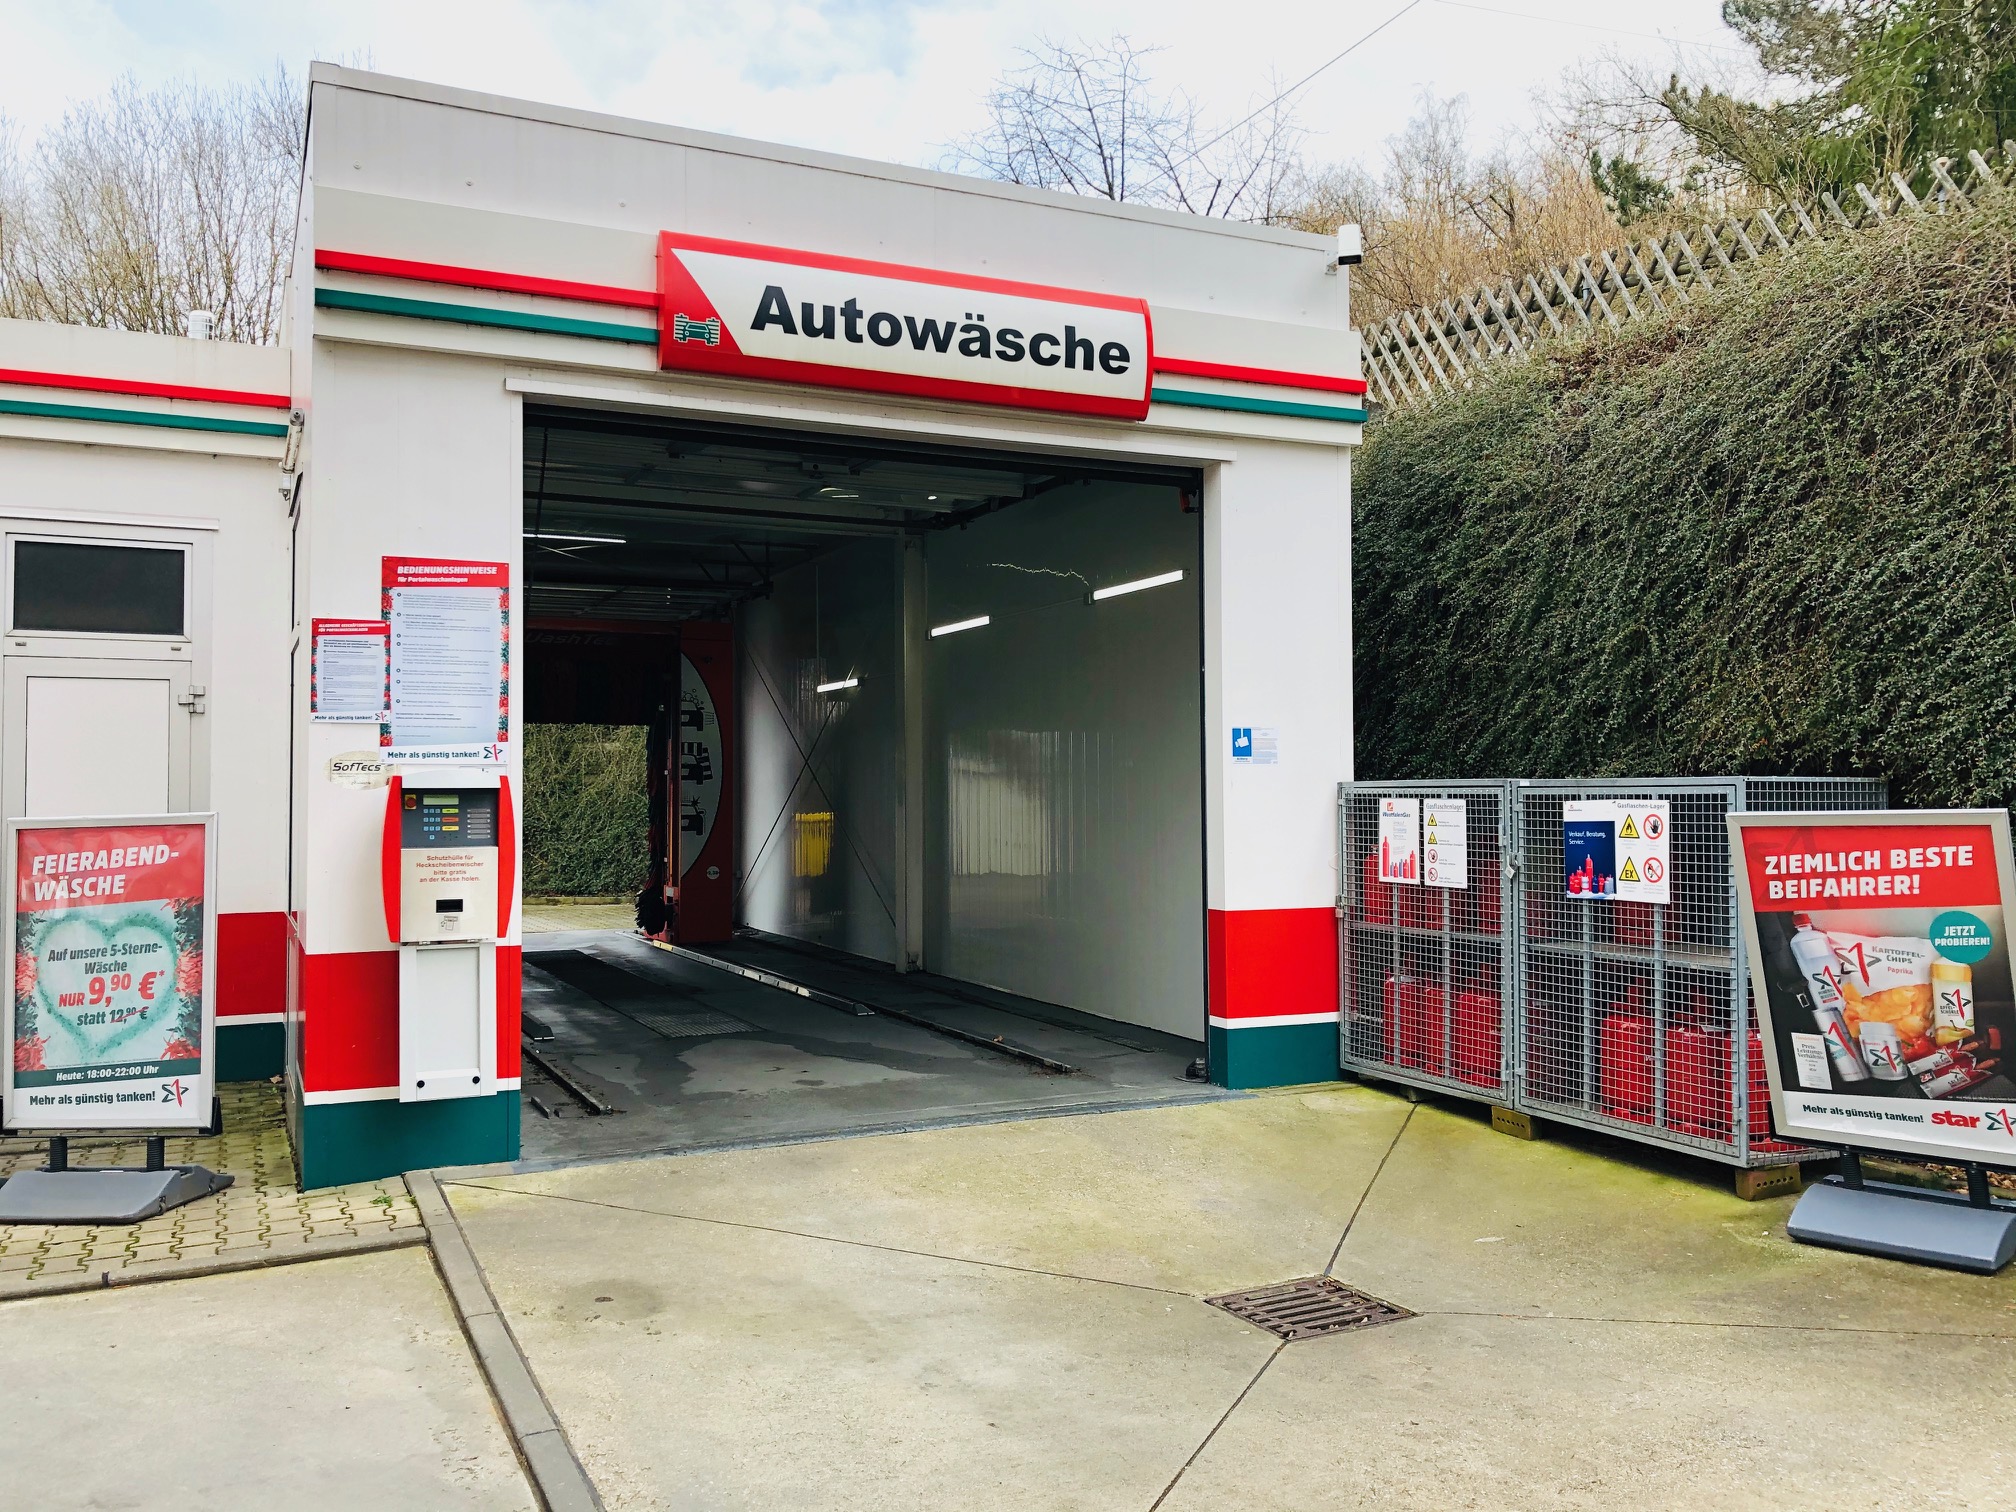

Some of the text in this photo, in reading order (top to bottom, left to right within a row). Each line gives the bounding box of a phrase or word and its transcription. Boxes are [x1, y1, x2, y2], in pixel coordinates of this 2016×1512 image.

[750, 284, 1131, 376] Autowäsche
[397, 566, 497, 575] BEDIENUNGSHINWEISE
[408, 576, 468, 584] Portalwaschanlagen
[387, 750, 480, 761] Mehr als günstig tanken!
[332, 762, 381, 772] SofTecs
[1426, 803, 1464, 811] Gasflaschenlager
[1617, 802, 1665, 810] Gasflaschen-Lager
[32, 844, 179, 876] FEIERABEND-
[1765, 845, 1973, 875] ZIEMLICH BESTE
[449, 869, 466, 877] gratis
[1625, 869, 1634, 879] EX
[34, 874, 126, 902] WÄSCHE
[1768, 875, 1921, 899] BEIFAHRER!
[1943, 925, 1976, 937] JETZT
[1934, 936, 1990, 946] PROBIEREN!
[48, 943, 162, 962] Auf unsere 5-Sterne-
[1872, 946, 1925, 958] KARTOFFEL-
[1886, 955, 1913, 964] CHIPS
[84, 960, 127, 975] Wäsche
[1887, 966, 1913, 975] Paprika
[58, 993, 84, 1008] NUR
[88, 975, 131, 1007] 9,90
[77, 1006, 149, 1026] statt 12,90 €
[56, 1065, 159, 1082] Heute: 18:00-22:00 Uhr
[29, 1091, 156, 1106] Mehr als günstig tanken!
[1802, 1104, 1981, 1129] Mehr als günstig tanken! star
